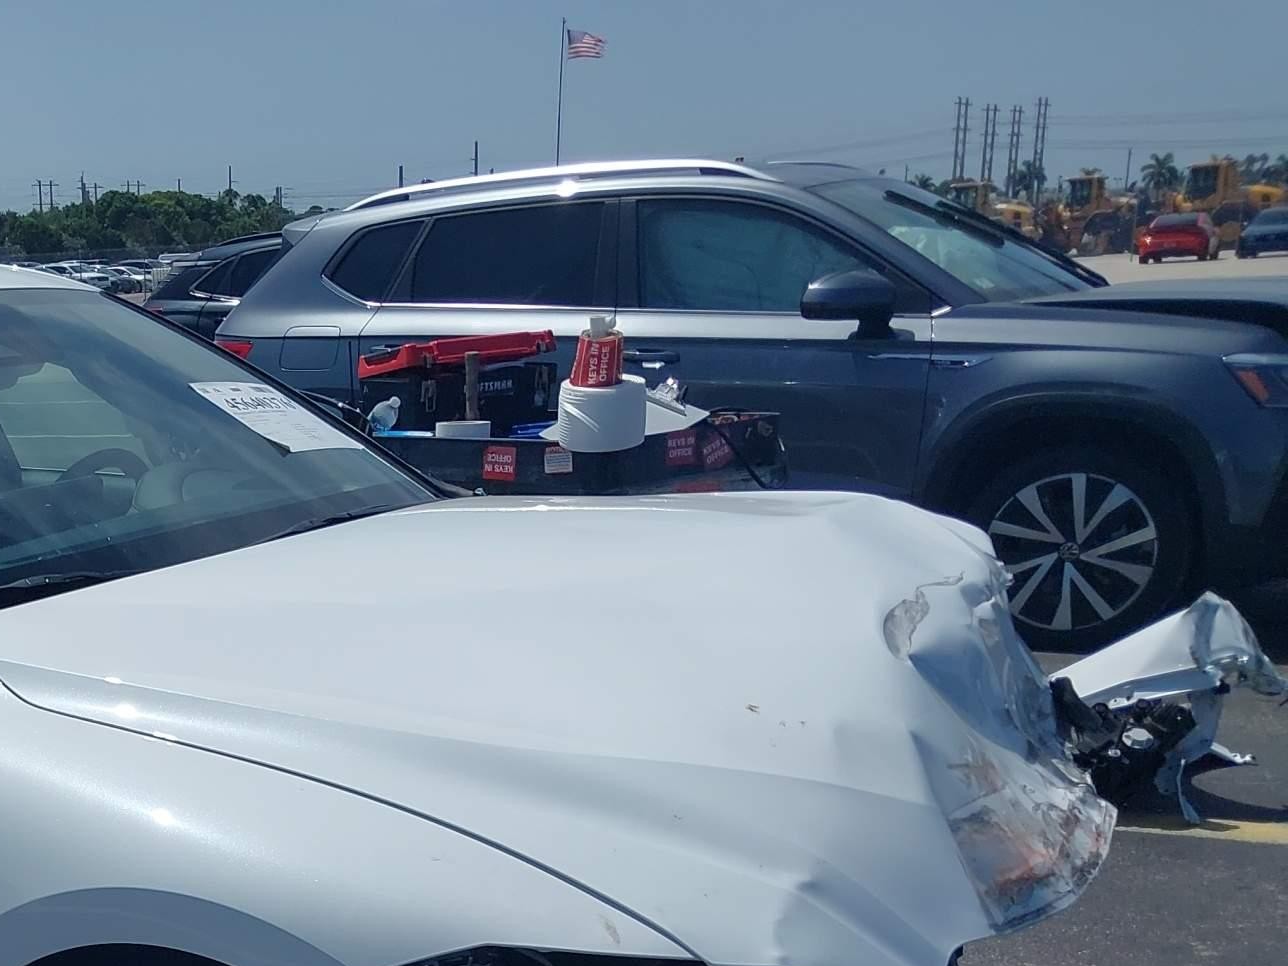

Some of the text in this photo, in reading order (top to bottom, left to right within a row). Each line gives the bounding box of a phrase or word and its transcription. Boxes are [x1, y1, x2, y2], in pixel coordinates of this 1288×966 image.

[587, 341, 600, 385] KEYS IN
[598, 344, 610, 382] OFFICE
[479, 379, 513, 392] FTSMAN
[487, 453, 513, 463] OFFICE
[484, 463, 514, 473] KEYS IN
